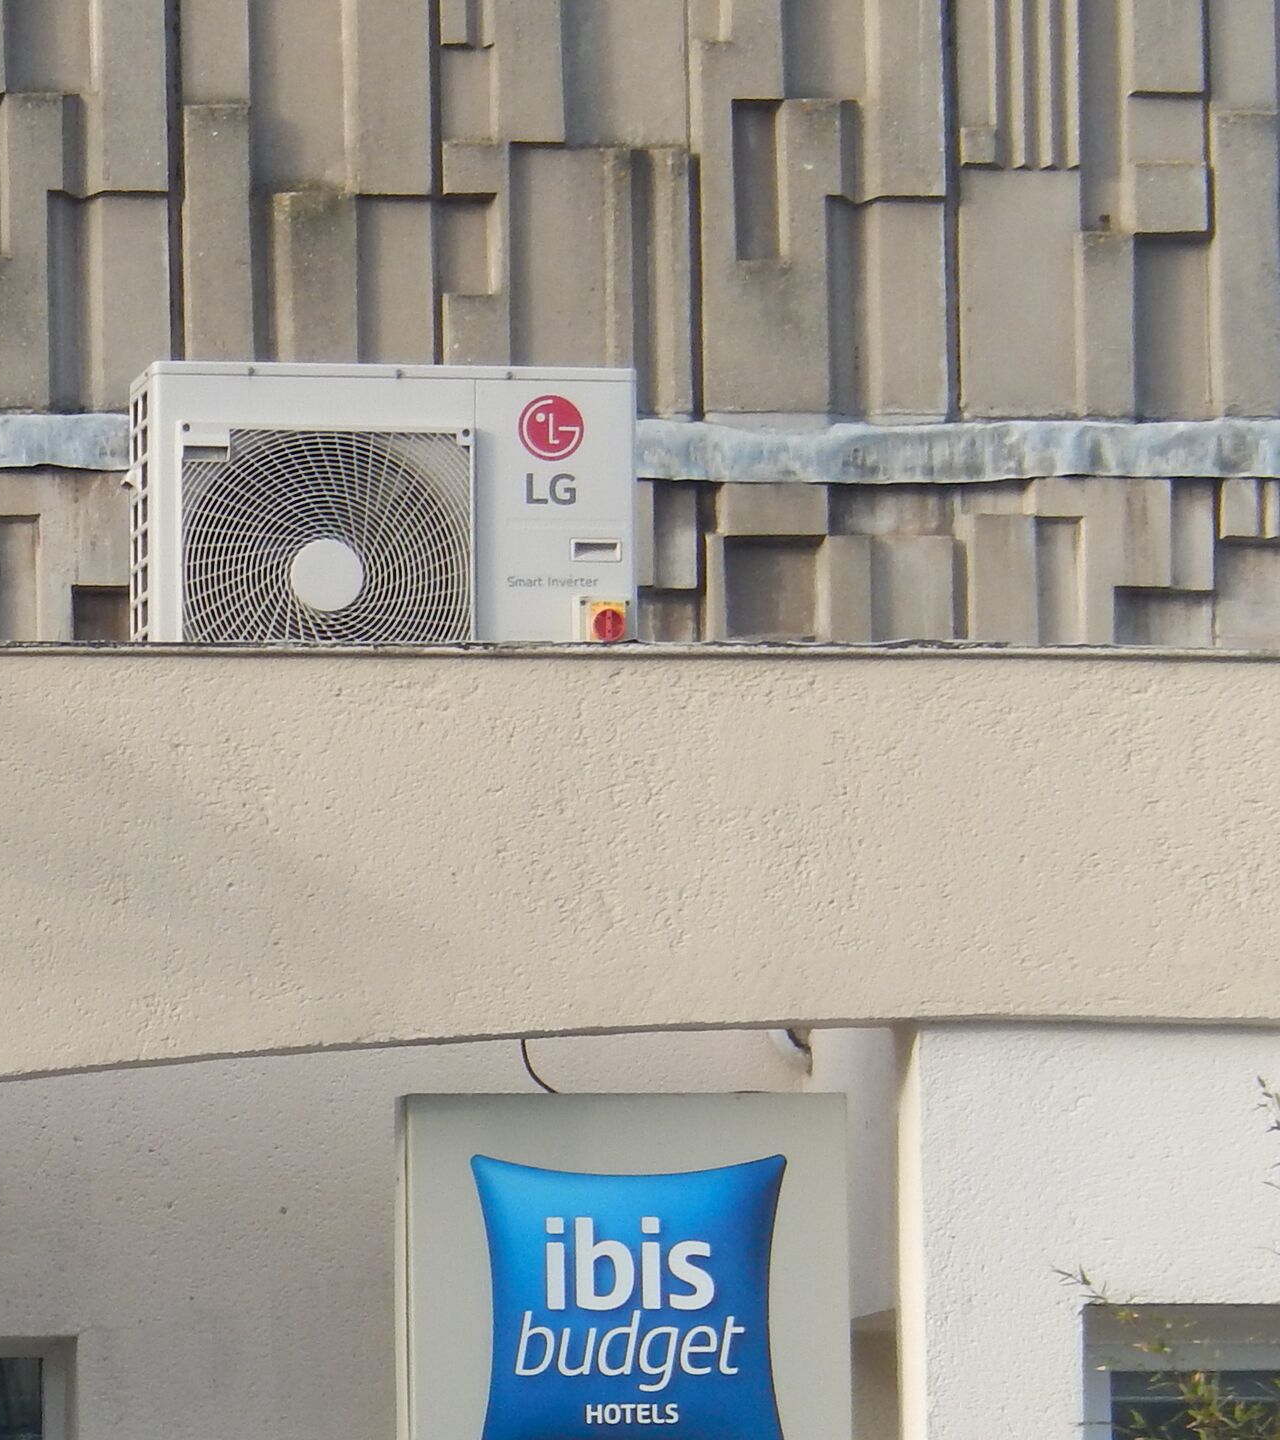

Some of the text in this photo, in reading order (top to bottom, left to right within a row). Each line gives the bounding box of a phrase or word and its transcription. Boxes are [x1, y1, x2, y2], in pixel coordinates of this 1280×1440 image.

[525, 473, 577, 505] LG
[506, 576, 600, 588] Smart Inverter
[545, 1217, 716, 1311] ibis
[514, 1310, 745, 1393] budget
[585, 1403, 679, 1425] HOTELS
